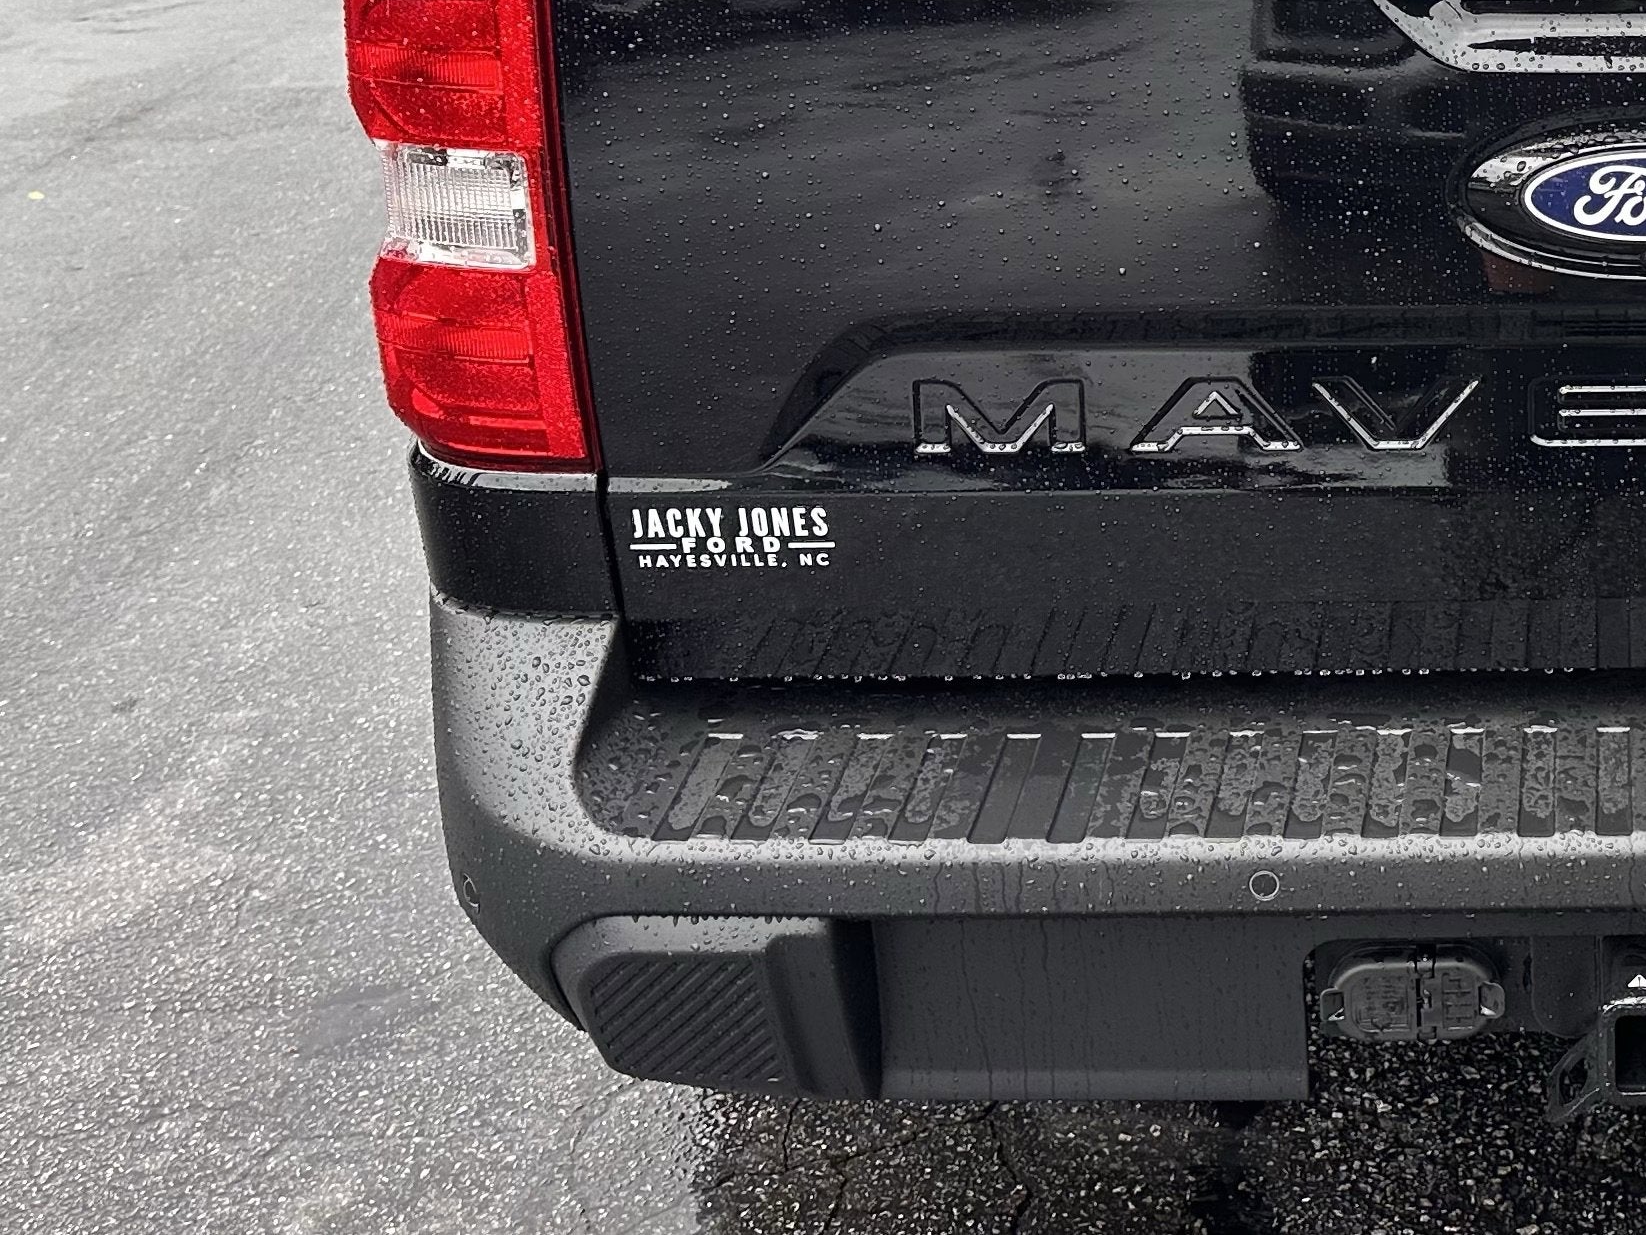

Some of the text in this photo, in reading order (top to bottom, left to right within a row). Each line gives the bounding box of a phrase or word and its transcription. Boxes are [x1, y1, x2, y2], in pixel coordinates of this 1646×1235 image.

[632, 507, 829, 538] JACKY JONES
[681, 536, 781, 553] FORD
[638, 553, 830, 568] HAYESVILLE, NC
